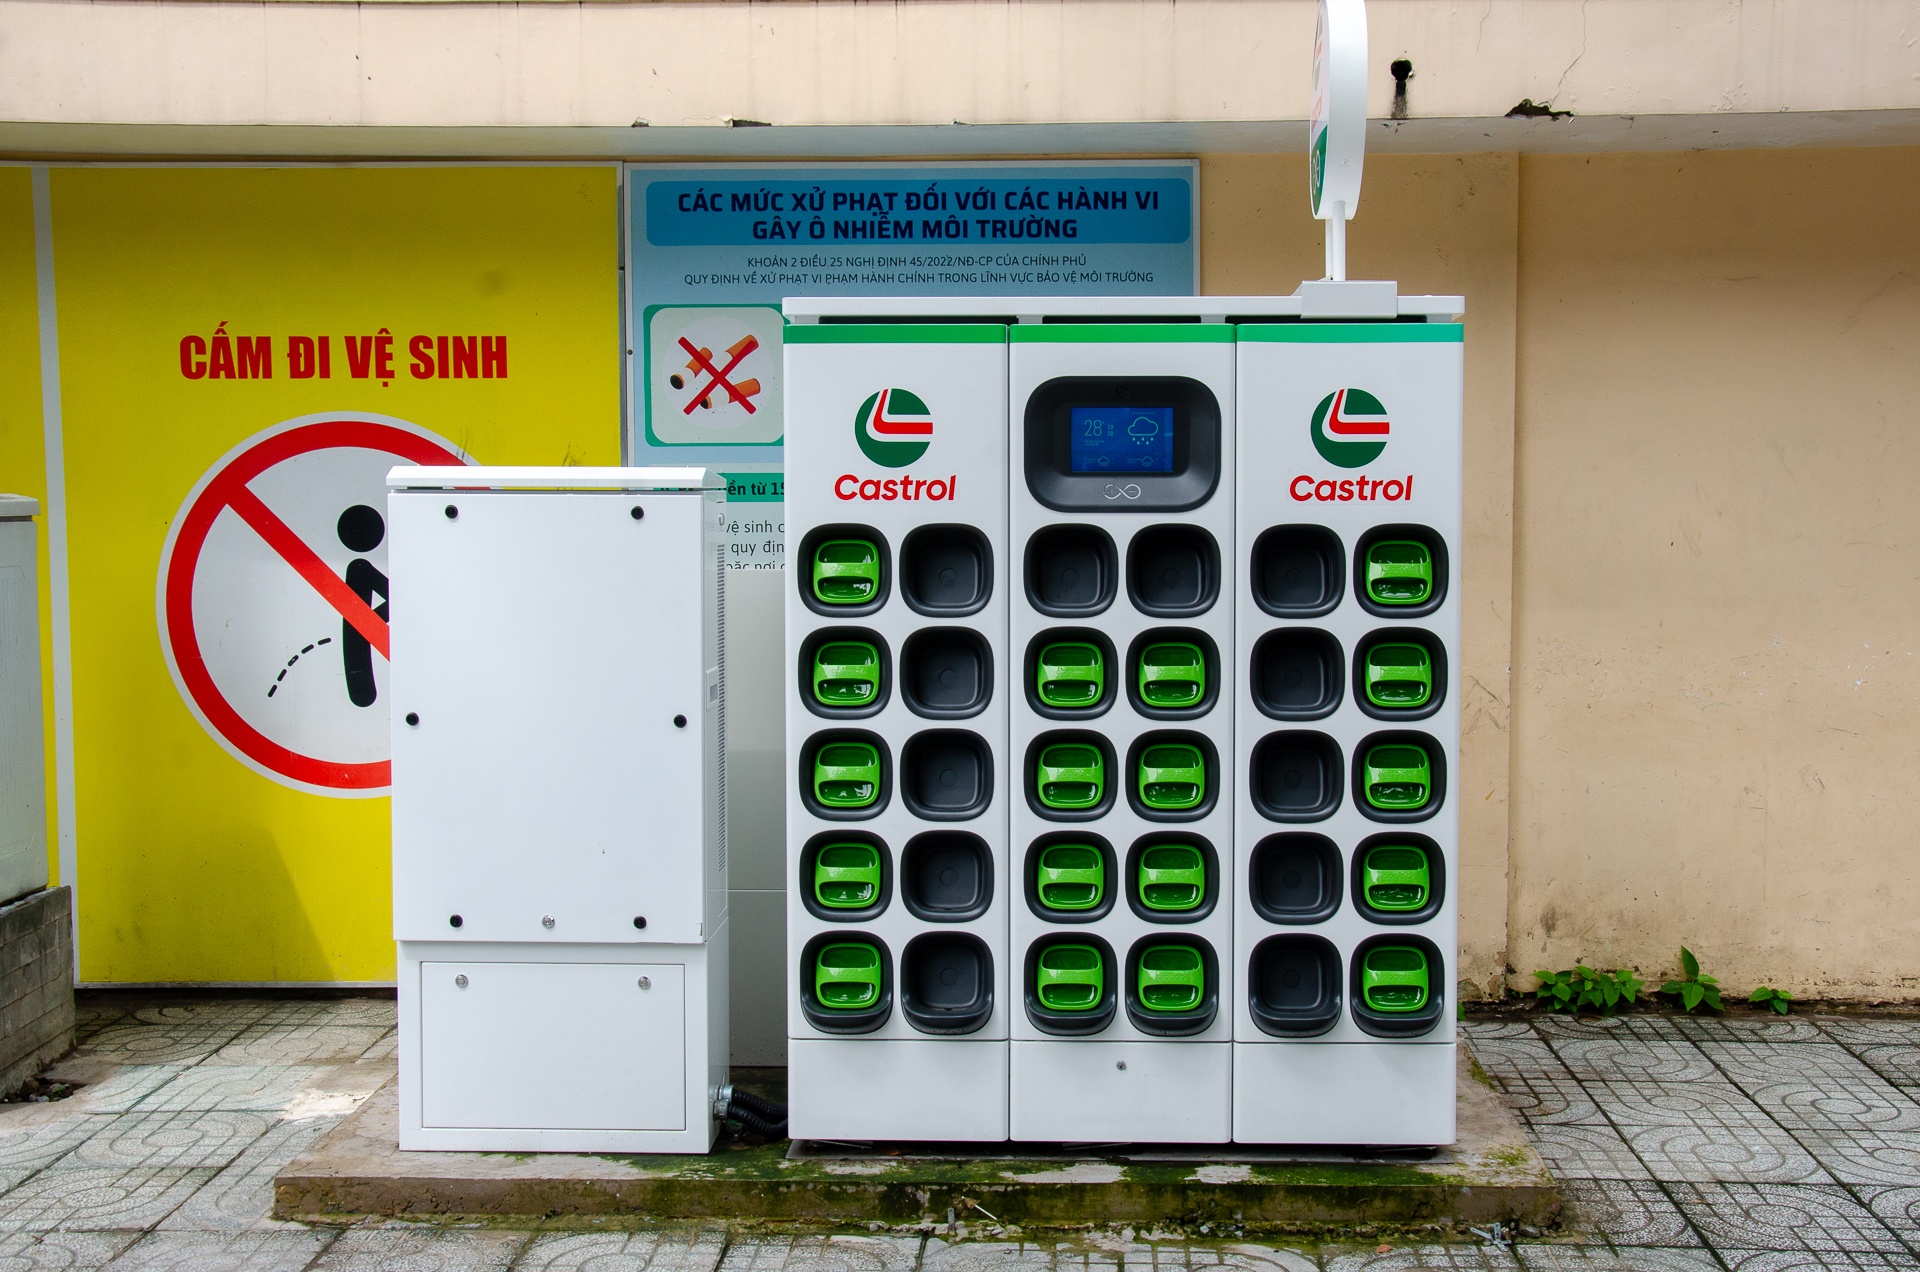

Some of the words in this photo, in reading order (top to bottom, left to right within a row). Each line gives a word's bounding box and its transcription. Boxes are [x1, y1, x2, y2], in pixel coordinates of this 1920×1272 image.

[678, 188, 723, 212] CÁC
[731, 188, 784, 212] MỨC
[791, 187, 827, 212] XỬ
[832, 192, 899, 216] PHẠT
[904, 183, 947, 211] ĐỐI
[955, 187, 996, 211] VỚI
[1004, 187, 1050, 211] CÁC
[1057, 187, 1127, 210] HÀNH
[1134, 191, 1159, 210] VI
[752, 216, 802, 240] GÂY
[809, 216, 826, 240] Ô
[833, 211, 914, 239] NHIỄM
[922, 215, 969, 239] MÔI
[975, 215, 1078, 239] TRƯỜNG
[747, 255, 788, 268] KHOẢN
[791, 257, 797, 268] 2
[800, 254, 827, 268] ĐIỀU
[830, 257, 843, 268] 25
[846, 256, 875, 269] NGHỊ
[877, 256, 907, 269] ĐỊNH
[909, 256, 993, 267] 45/2022/NĐ-CP
[995, 254, 1020, 267] CỦA
[1022, 254, 1059, 266] CHÍNH
[1062, 254, 1087, 266] PHỦ
[684, 274, 709, 285] QUY
[711, 274, 740, 286] ĐỊNH
[743, 271, 757, 284] VỀ
[760, 271, 777, 284] XỬ
[779, 273, 809, 286] PHẠT
[811, 274, 822, 284] VI
[826, 273, 858, 286] PHẠM
[861, 271, 895, 284] HÀNH
[898, 271, 935, 283] CHÍNH
[938, 272, 977, 283] TRONG
[980, 270, 1007, 283] LĨNH
[1010, 271, 1034, 284] VỰC
[1037, 270, 1060, 282] BẢO
[1063, 270, 1077, 284] VỆ
[1080, 270, 1102, 282] MÔI
[1105, 270, 1154, 283] TRƯỜNG
[179, 321, 273, 380] CẤM
[287, 335, 331, 380] ĐI
[344, 328, 396, 388] VỆ
[408, 335, 508, 380] SINH
[727, 479, 747, 496] ền
[750, 481, 768, 496] từ
[834, 474, 957, 502] Castrol
[1289, 474, 1413, 502] Castrol
[744, 520, 773, 533] sinh
[731, 543, 757, 556] quy
[762, 540, 785, 555] địn
